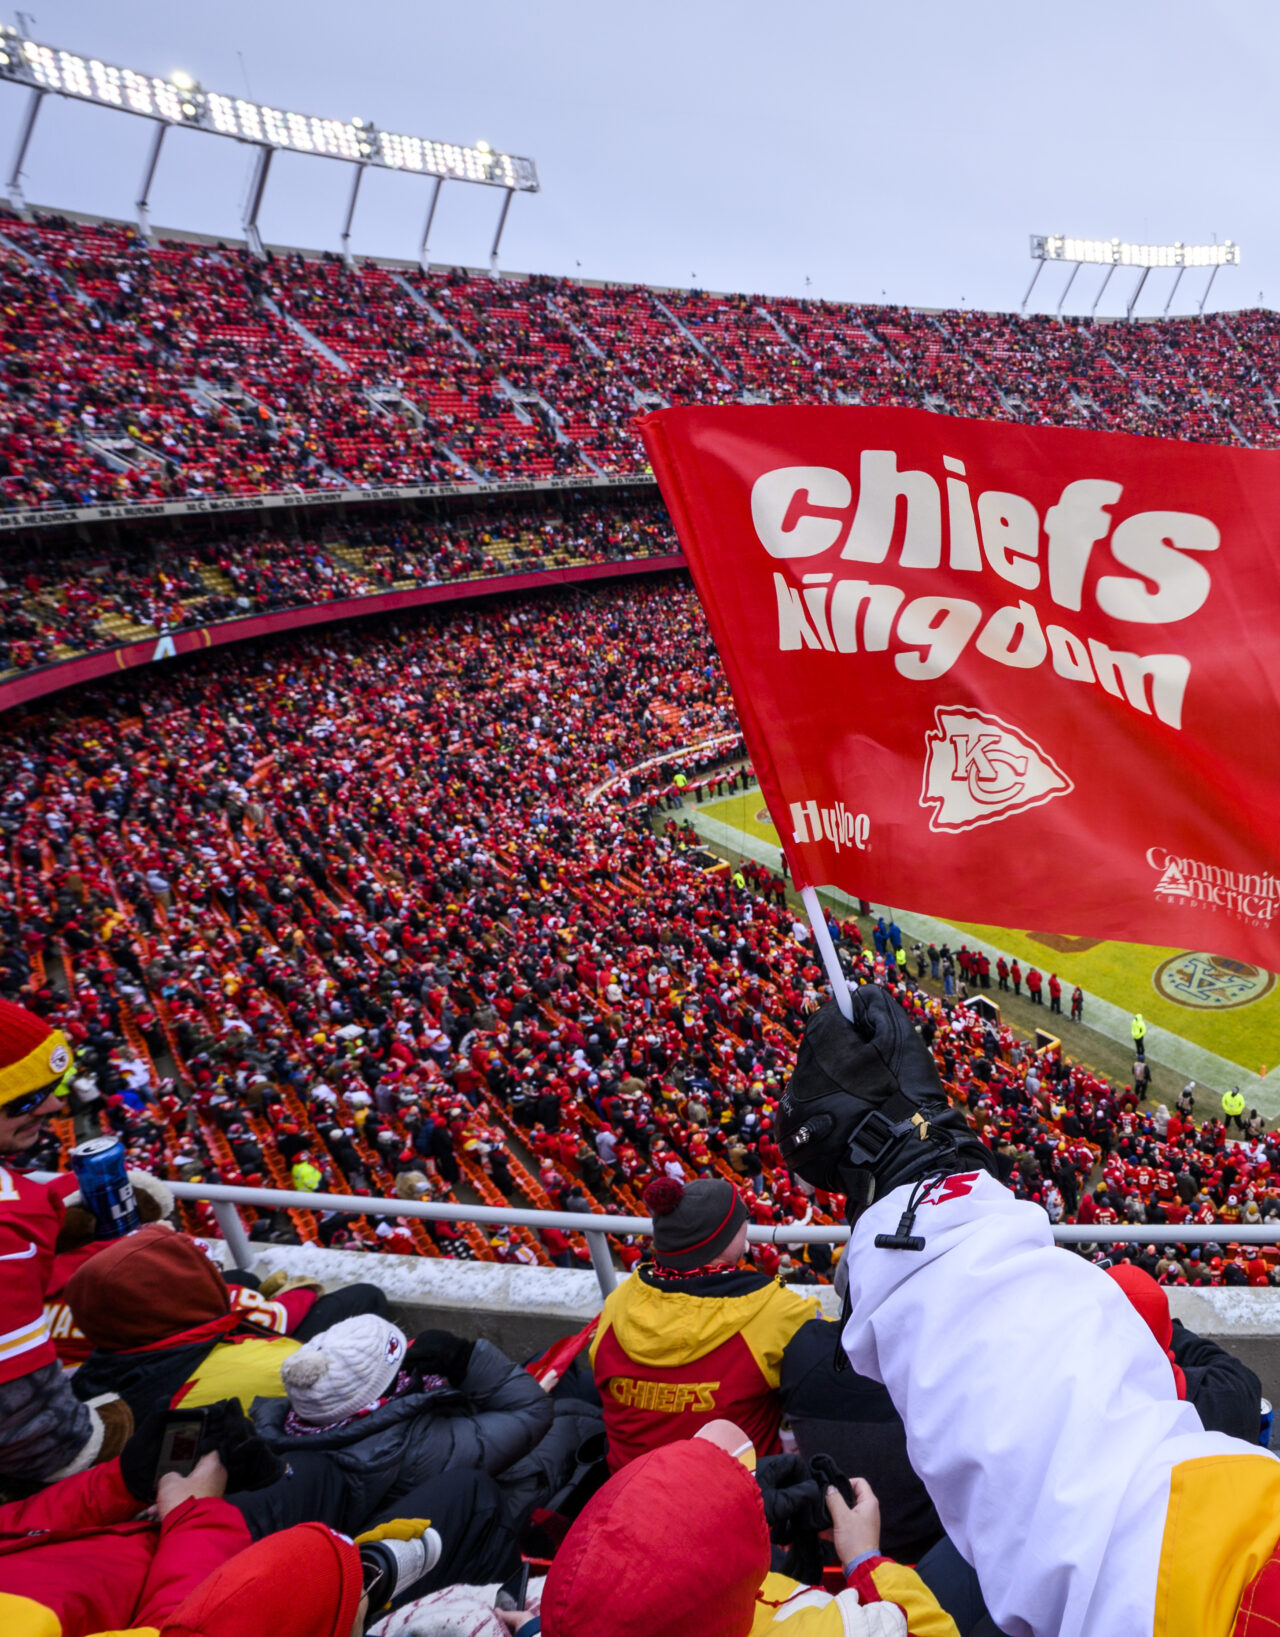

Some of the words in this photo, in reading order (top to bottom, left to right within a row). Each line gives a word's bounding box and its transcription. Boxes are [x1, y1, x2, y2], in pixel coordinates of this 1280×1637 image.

[751, 450, 1220, 624] chiefs
[774, 572, 1191, 731] kingdom
[609, 1376, 720, 1413] CHIEFS
